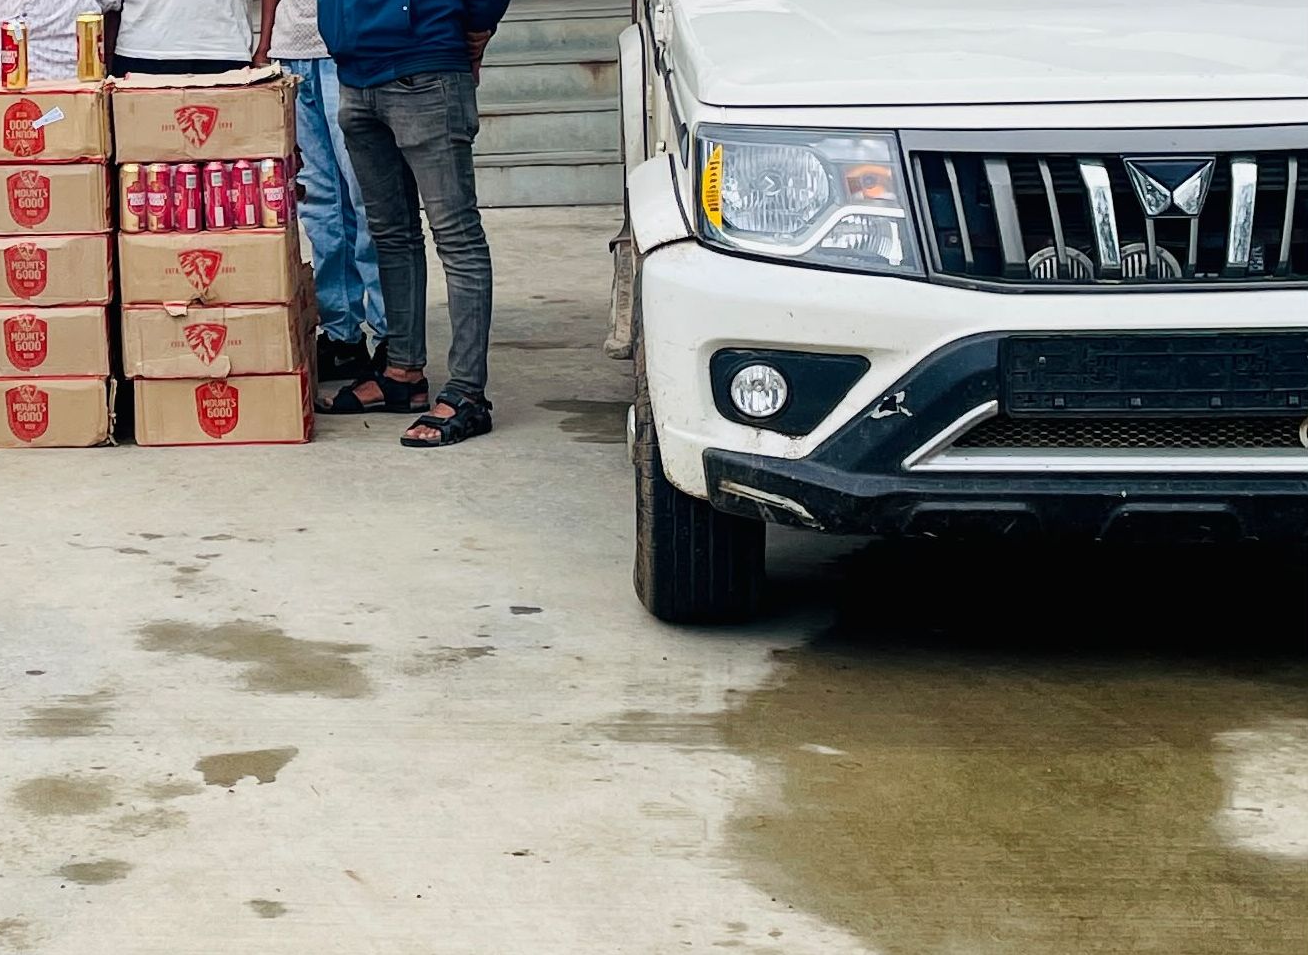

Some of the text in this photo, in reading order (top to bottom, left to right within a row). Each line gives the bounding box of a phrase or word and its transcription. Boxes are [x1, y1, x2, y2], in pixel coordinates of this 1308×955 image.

[13, 188, 48, 198] MOUNTS
[18, 198, 44, 208] 6000
[11, 260, 46, 270] MOUNTS
[15, 270, 41, 280] 6000
[11, 331, 46, 341] MOUNTS
[15, 341, 41, 352] 6000
[12, 402, 47, 412] MOUNTS
[202, 398, 237, 408] MOUNTS
[16, 412, 43, 422] 6000
[207, 408, 233, 418] 6000
